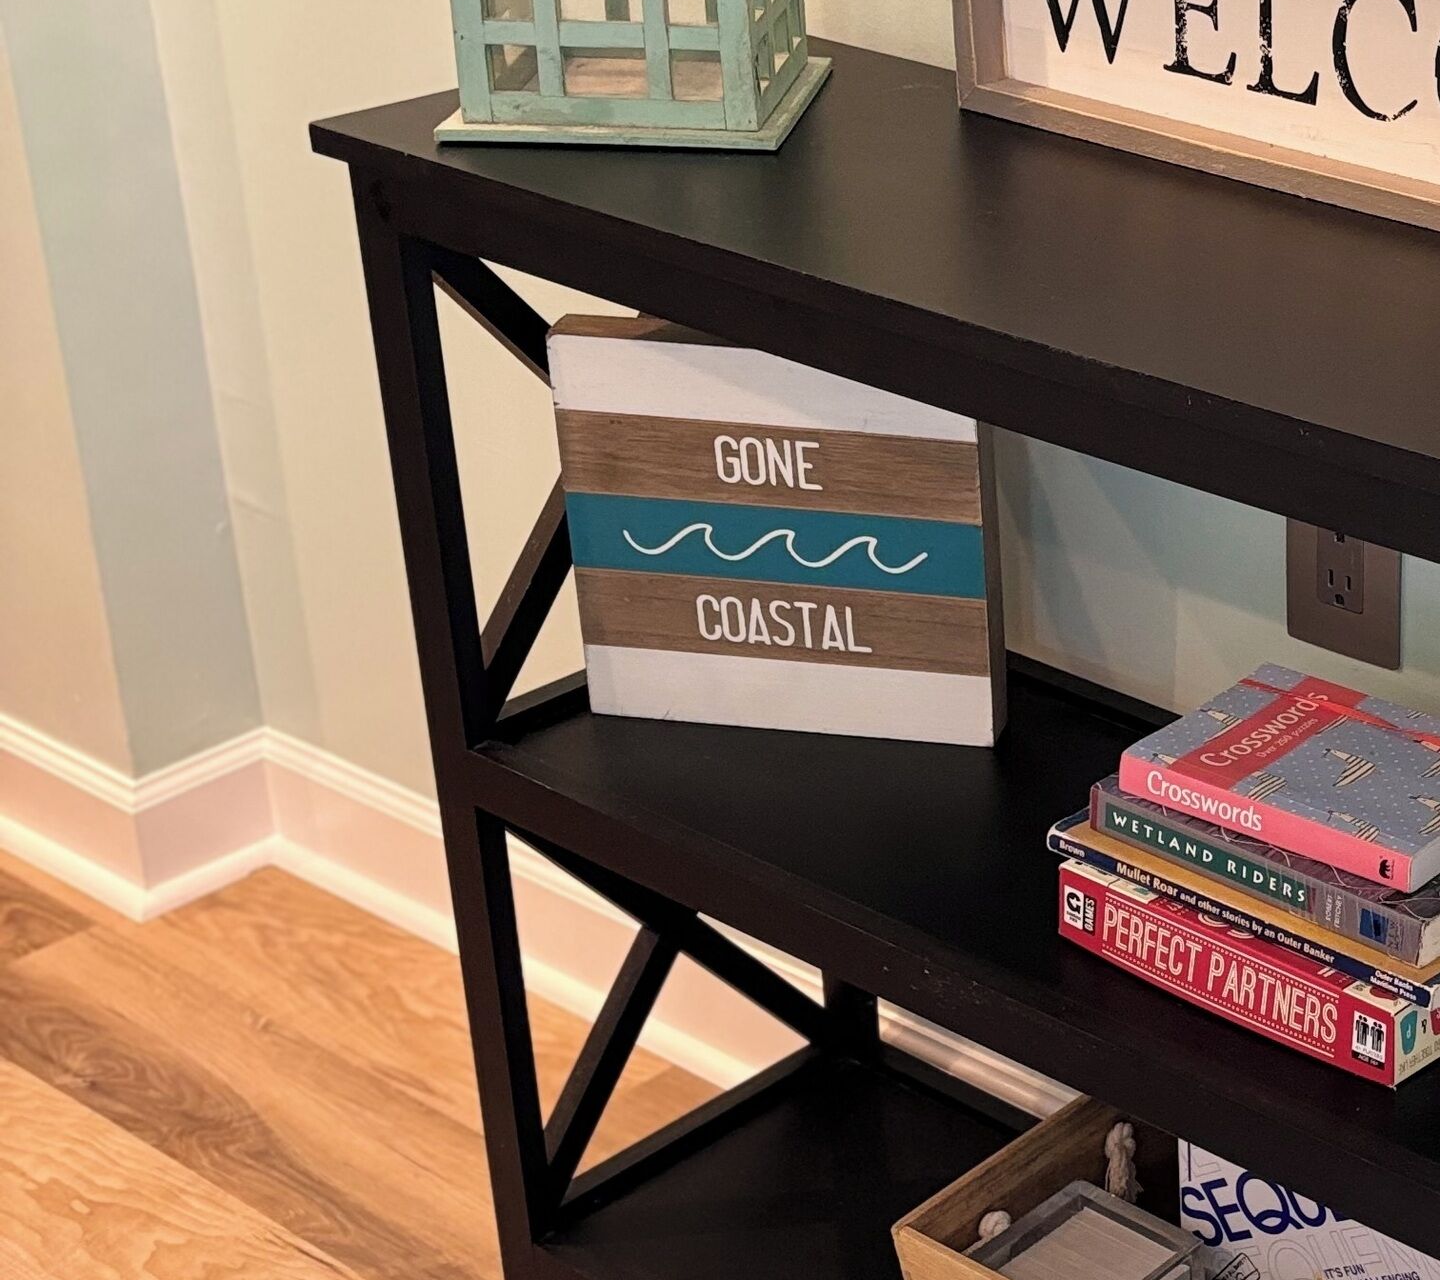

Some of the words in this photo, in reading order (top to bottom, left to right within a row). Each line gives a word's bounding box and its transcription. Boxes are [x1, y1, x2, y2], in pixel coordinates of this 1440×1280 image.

[713, 434, 824, 492] GONE
[695, 593, 873, 655] COASTAL
[1199, 691, 1329, 767] Crosswords
[1146, 769, 1263, 832] Crosswords
[1058, 839, 1086, 859] Brown
[1112, 811, 1214, 863] WETLAND
[1226, 859, 1306, 903] RIDERS
[1084, 897, 1095, 932] GAMES
[1115, 861, 1151, 887] Mullet
[1152, 879, 1179, 898] Roar
[1179, 890, 1197, 905] and
[1197, 900, 1221, 916] other
[1221, 908, 1250, 929] stories
[1252, 921, 1263, 936] by
[1264, 927, 1276, 939] an
[1277, 932, 1303, 950] Outer
[1303, 942, 1336, 964] Banker
[1101, 900, 1203, 982] PERFECT
[1206, 951, 1338, 1044] PARTNERS
[1180, 1170, 1352, 1248] SEQU
[1324, 1266, 1344, 1280] IT'S
[1344, 1263, 1366, 1277] FUN
